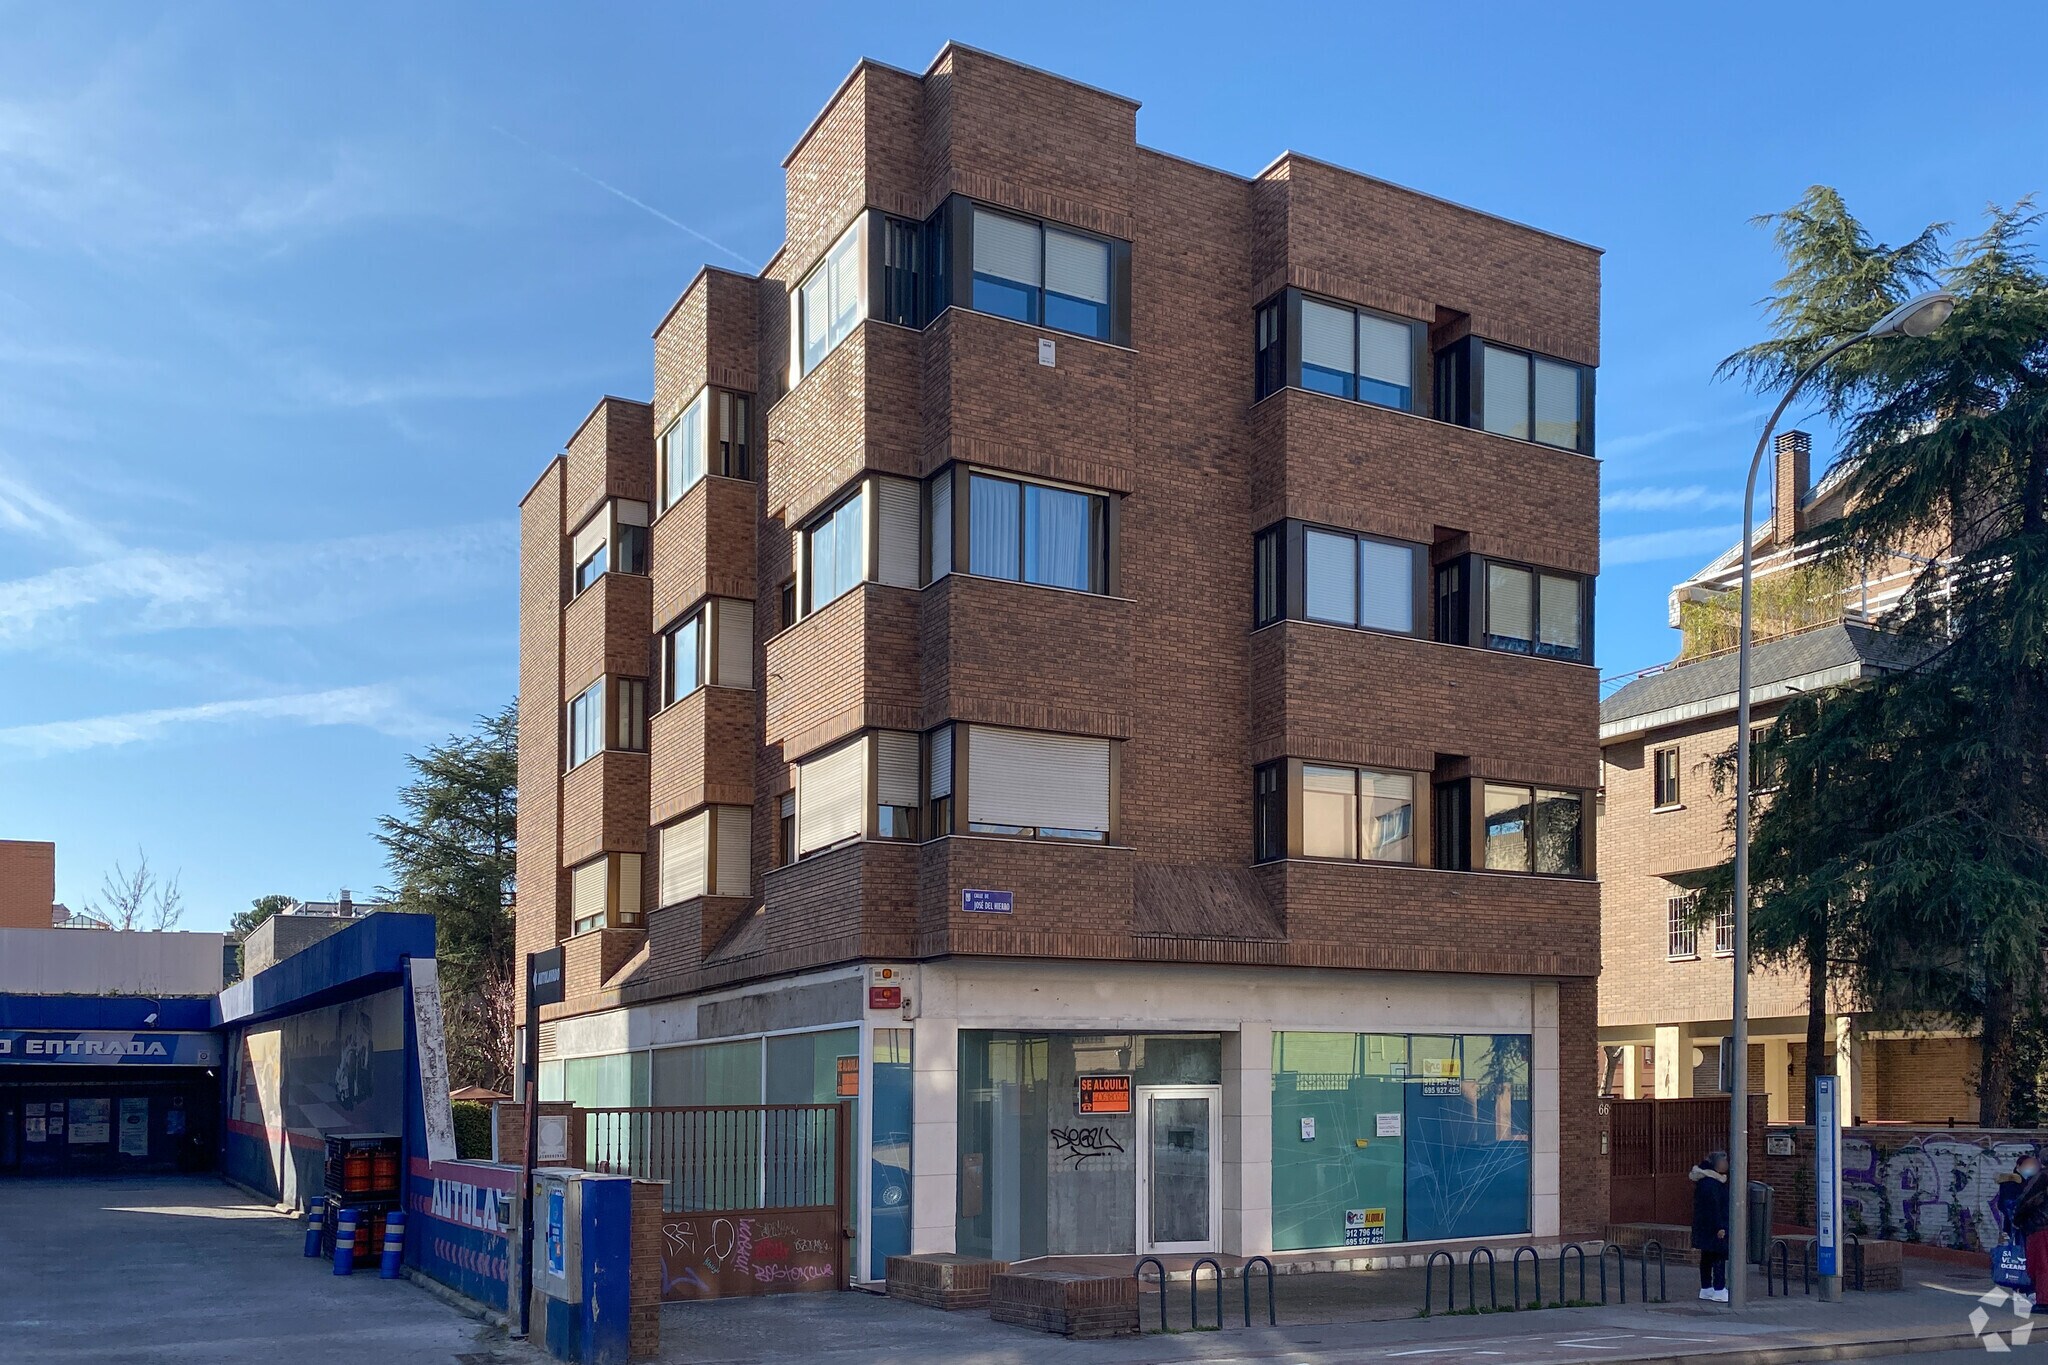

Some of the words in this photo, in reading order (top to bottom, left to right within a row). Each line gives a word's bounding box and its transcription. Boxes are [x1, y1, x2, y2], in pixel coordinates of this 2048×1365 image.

[974, 900, 984, 910] JOSÉ
[985, 902, 993, 910] DEL
[26, 1040, 167, 1056] ENTRADA
[1081, 1079, 1092, 1091] SE
[1093, 1078, 1129, 1090] ALQUILA
[1449, 1086, 1460, 1094] 425
[1598, 1103, 1610, 1116] 66
[1346, 1229, 1358, 1237] 912
[1359, 1228, 1371, 1237] 796
[1371, 1227, 1384, 1236] 464
[1345, 1238, 1358, 1246] 695
[1358, 1237, 1371, 1245] 927
[1371, 1236, 1384, 1244] 425
[2000, 1263, 2027, 1271] OCEANS
